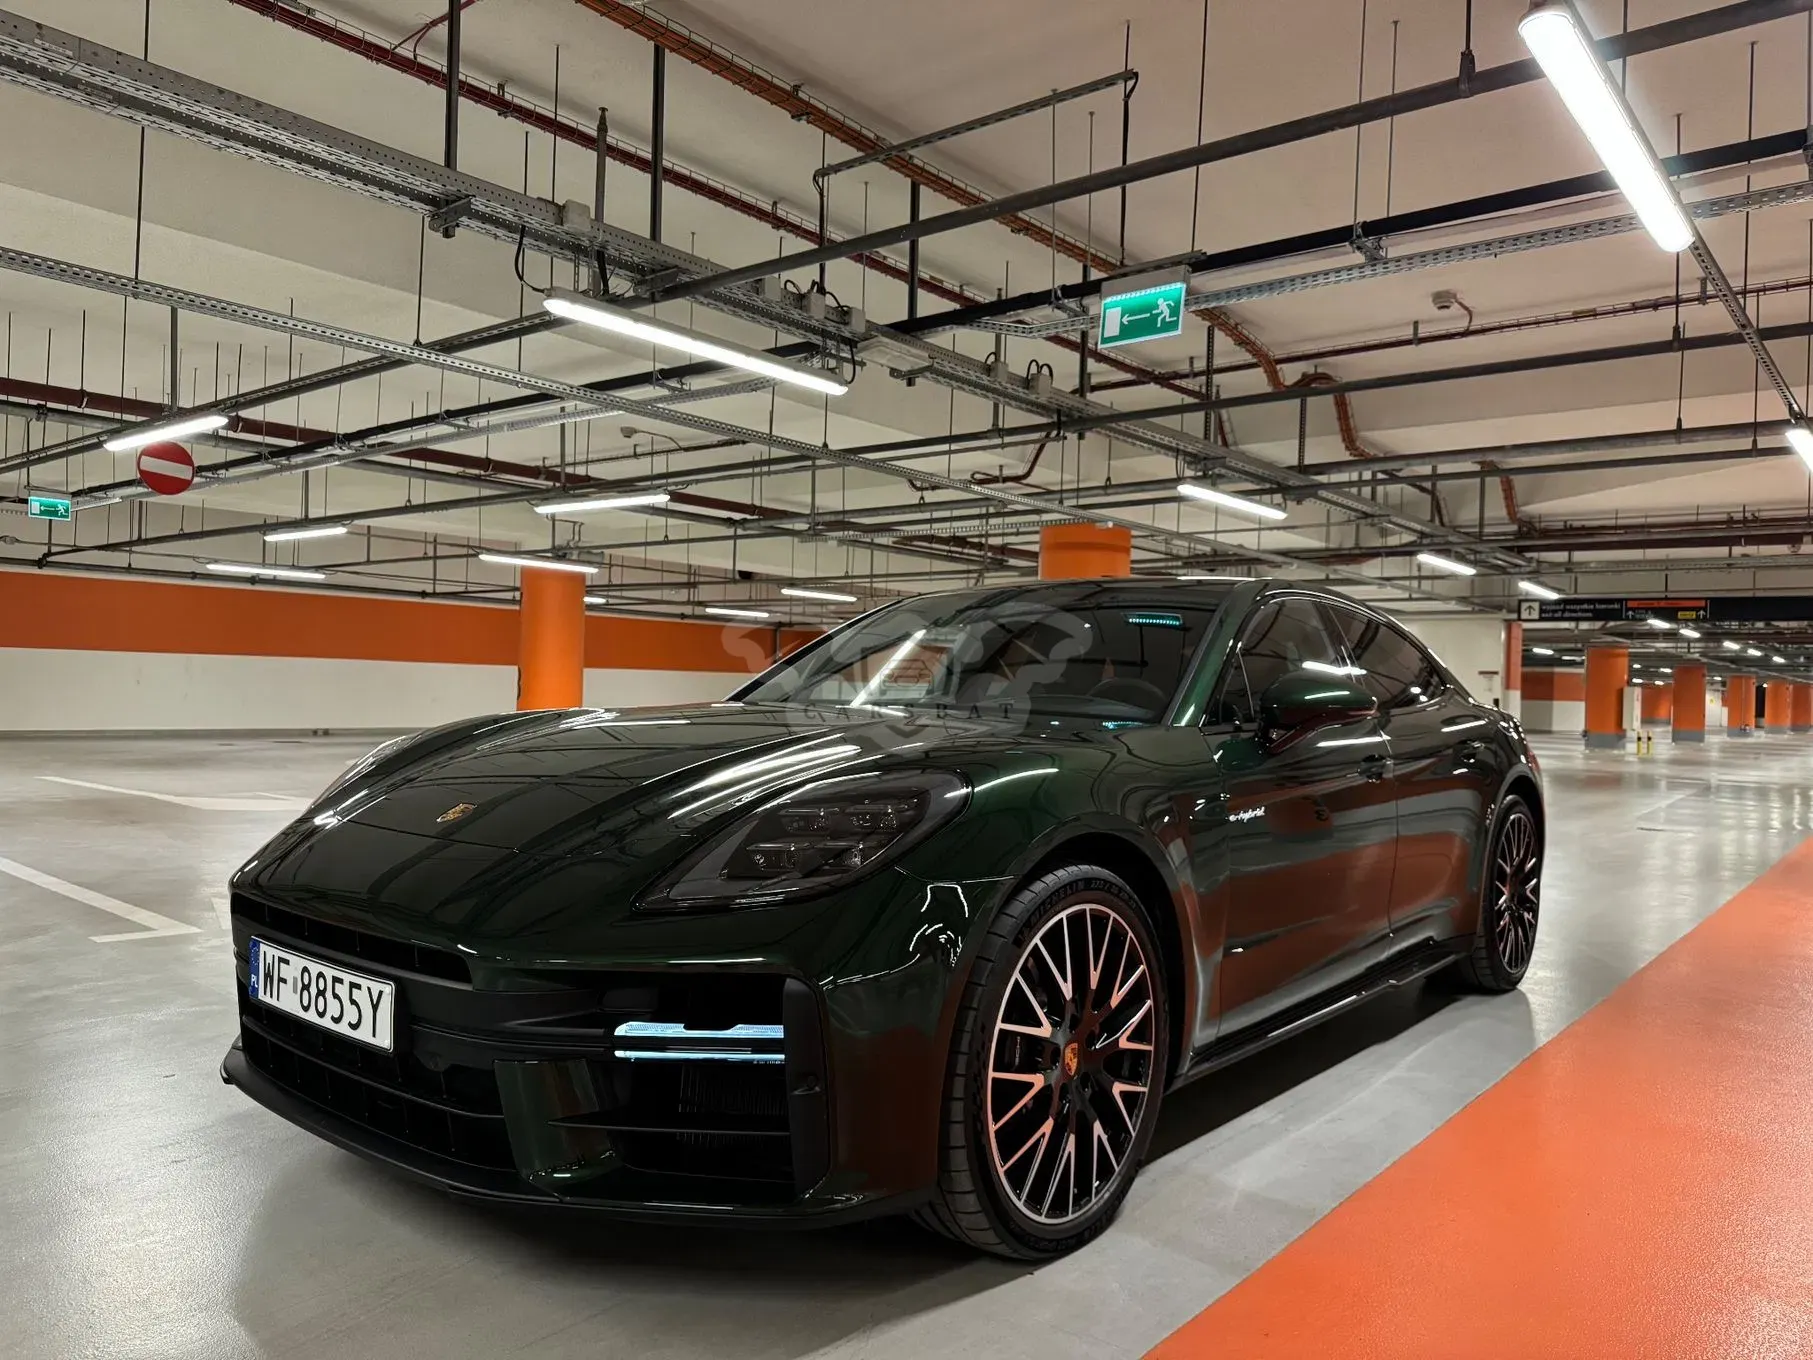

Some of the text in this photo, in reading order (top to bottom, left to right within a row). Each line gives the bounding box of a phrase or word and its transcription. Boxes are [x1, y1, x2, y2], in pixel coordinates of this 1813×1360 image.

[251, 974, 258, 988] PL
[263, 950, 384, 1038] WF 8855Y
